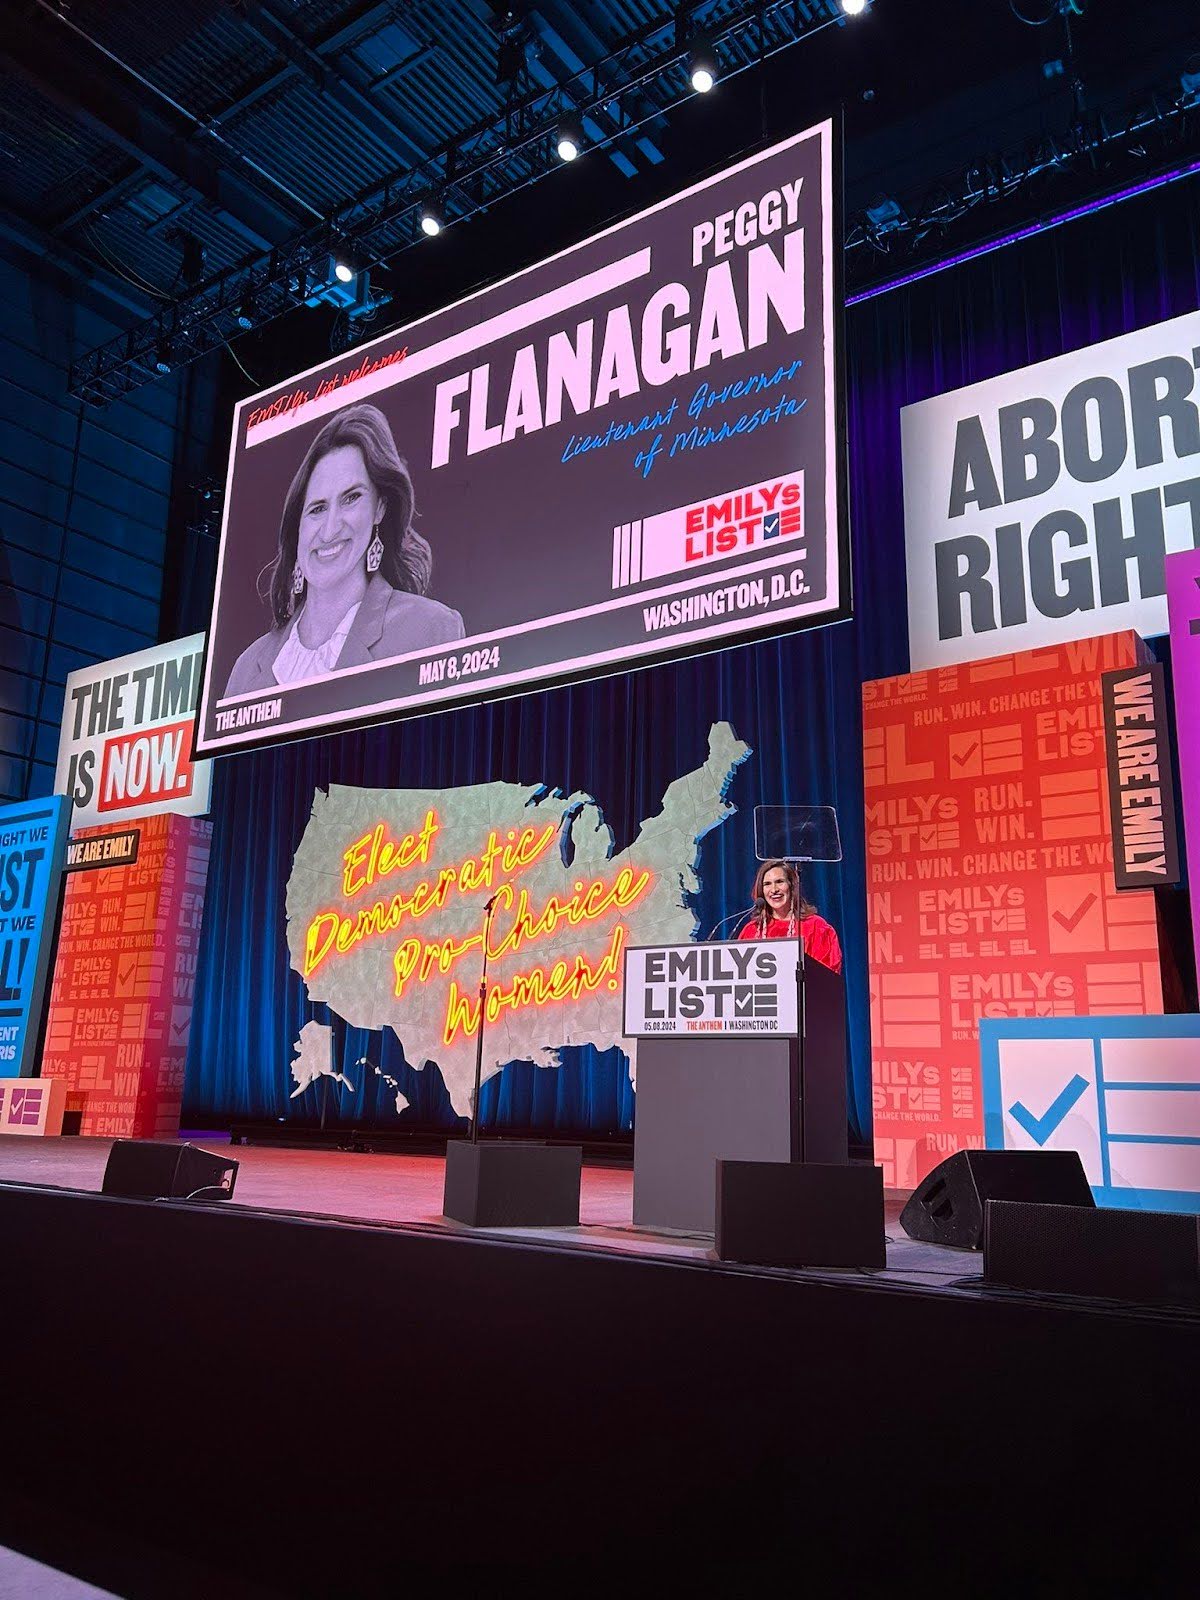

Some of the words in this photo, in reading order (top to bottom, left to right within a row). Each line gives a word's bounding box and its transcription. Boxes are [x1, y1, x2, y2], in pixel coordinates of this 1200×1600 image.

[692, 177, 804, 268] PEGGY
[430, 227, 805, 470] FLANAGAN
[341, 346, 408, 387] welcomes
[561, 398, 679, 463] Lieutenant
[688, 360, 803, 420] Governor
[634, 434, 663, 478] of
[670, 394, 807, 458] Minnesota
[948, 346, 1200, 519] ABOR
[685, 518, 762, 562] LIST
[643, 578, 769, 632] WASHINGTON,
[771, 569, 810, 602] D.C.
[419, 661, 446, 685] MAY
[71, 673, 129, 741] THE
[215, 711, 235, 731] THE
[235, 699, 282, 727] ANTHEM
[913, 706, 948, 727] RUN.
[951, 702, 986, 721] WIN.
[989, 689, 1050, 714] CHANGE
[1052, 682, 1086, 702] THE
[1113, 672, 1154, 726] WE
[67, 749, 95, 808] IS
[103, 729, 187, 802] NOW.
[1116, 729, 1161, 786] ARE
[974, 782, 1033, 813] RUN.
[29, 825, 49, 843] WE
[975, 813, 1035, 844] WIN.
[1120, 787, 1167, 876] EMILY
[67, 844, 84, 864] WE
[84, 841, 102, 863] ARE
[102, 835, 134, 860] EMILY
[343, 810, 438, 896] Elect
[872, 861, 912, 883] RUN.
[916, 856, 958, 880] WIN.
[962, 849, 1037, 876] CHANGE
[1040, 845, 1082, 869] THE
[0, 847, 46, 913] ST
[101, 897, 122, 914] RUN.
[303, 826, 555, 976] Democratic
[919, 883, 1025, 912] EMILYs
[11, 914, 37, 932] WE
[100, 915, 121, 933] WIN.
[394, 868, 649, 996] Pro-Choice
[919, 909, 992, 937] LIST
[93, 937, 119, 951] CHANGE
[120, 935, 135, 949] THE
[72, 971, 98, 986] LIST
[74, 957, 112, 973] EMILYs
[644, 985, 733, 1019] LIST
[950, 971, 1075, 1000] EMILYs
[74, 1024, 105, 1040] LIST
[76, 1006, 120, 1024] EMILYs
[644, 1021, 677, 1031] 05.08.2024
[686, 1021, 698, 1030] THE
[698, 1020, 722, 1030] ANTHEM
[729, 1020, 769, 1031] WASHINGTON
[769, 1019, 779, 1030] DC
[900, 1112, 914, 1121] THE
[914, 1112, 941, 1122] WORLD.
